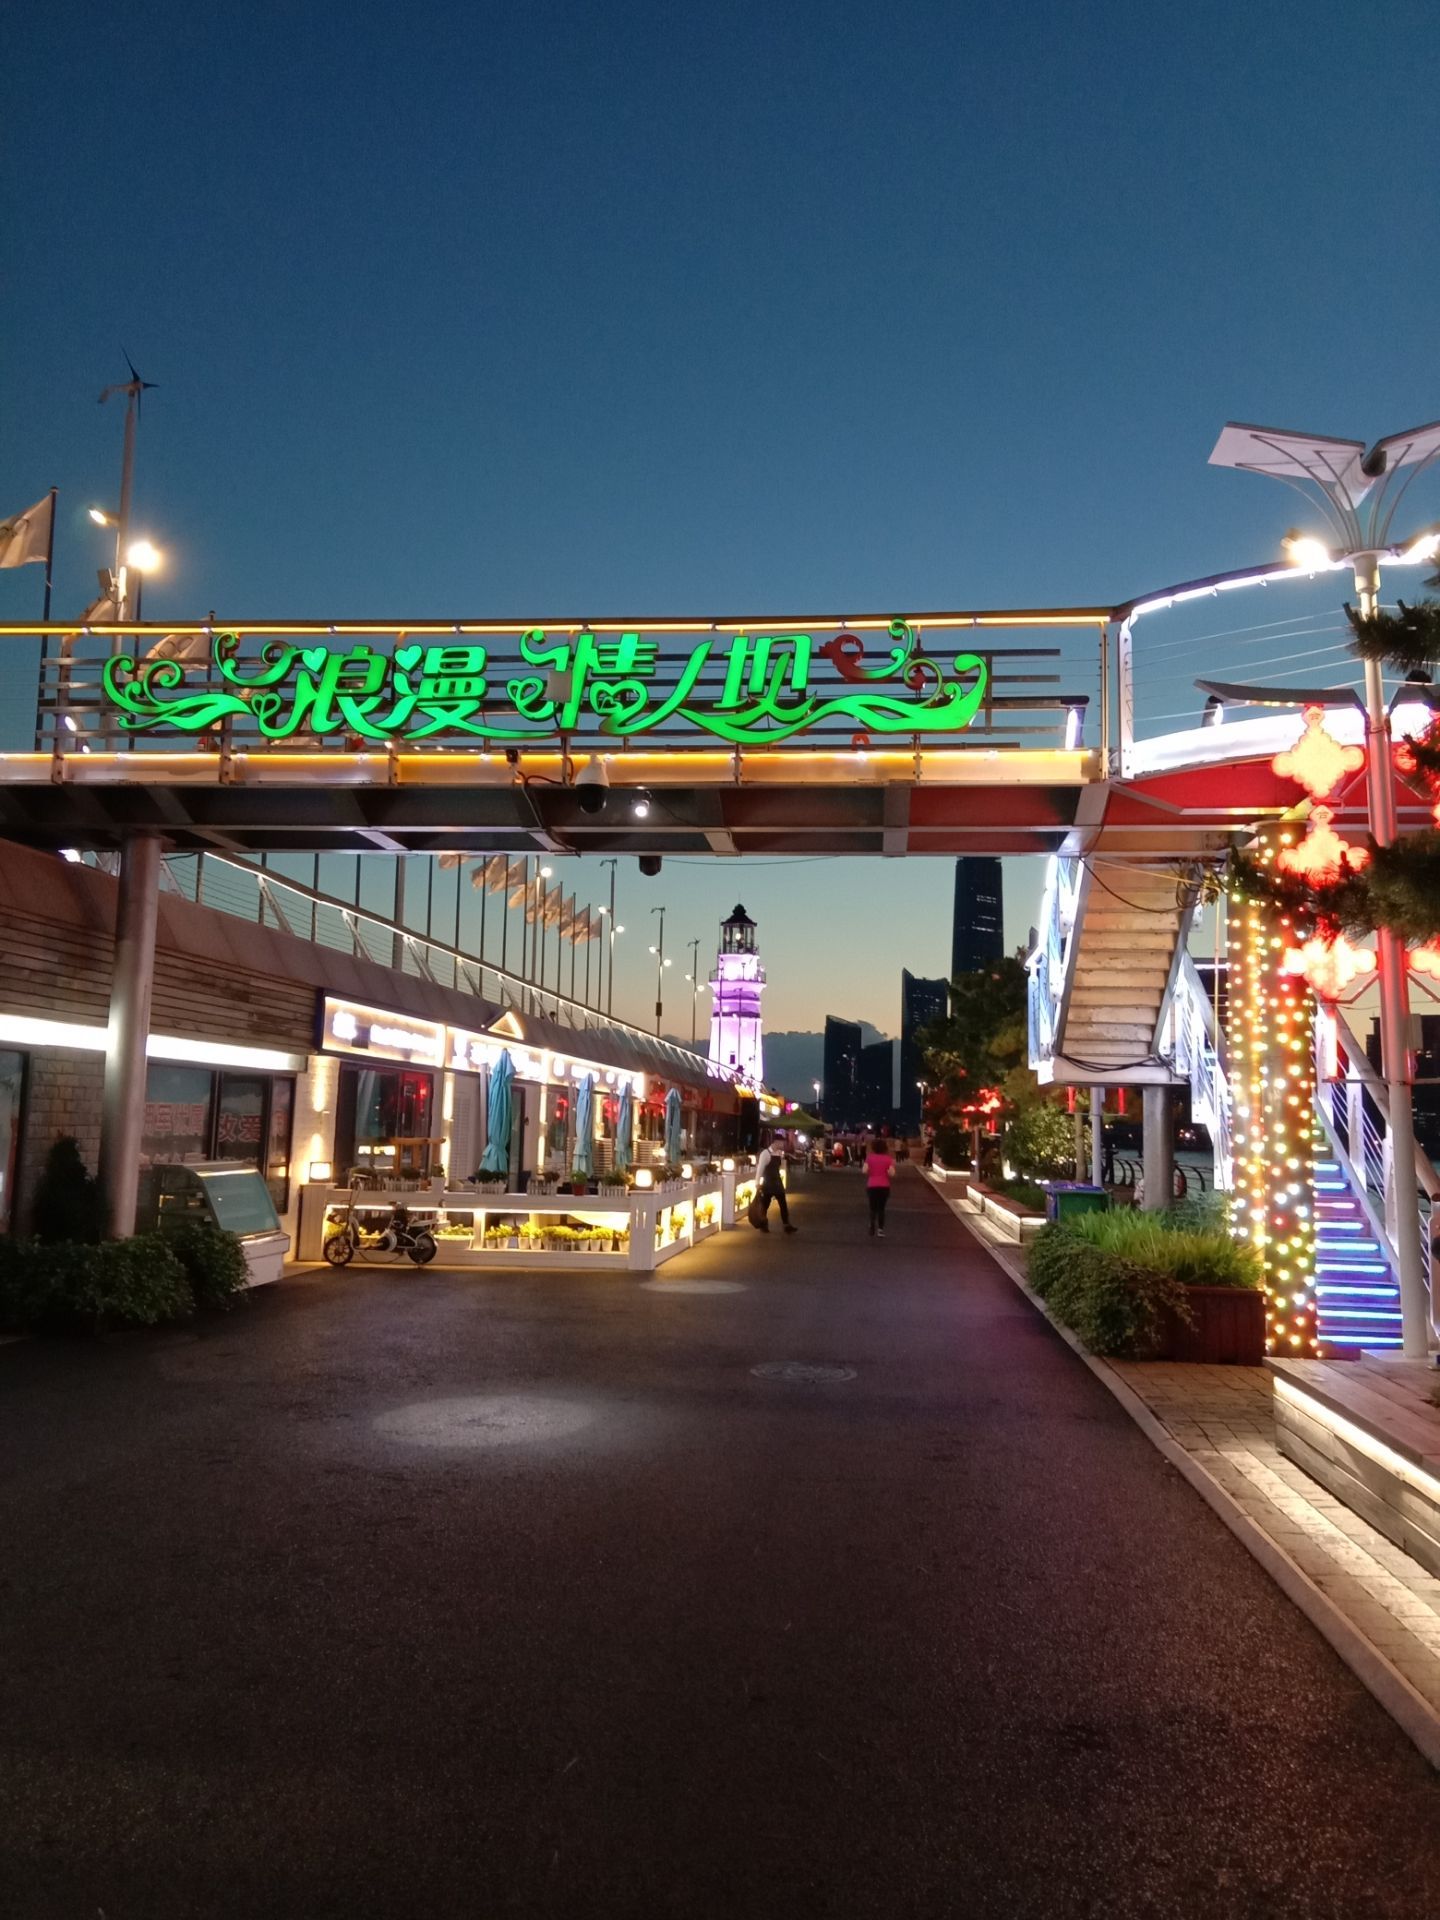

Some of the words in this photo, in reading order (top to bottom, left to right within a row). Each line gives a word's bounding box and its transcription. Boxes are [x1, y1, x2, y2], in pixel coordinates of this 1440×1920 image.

[250, 630, 822, 744] 浪漫情人坝
